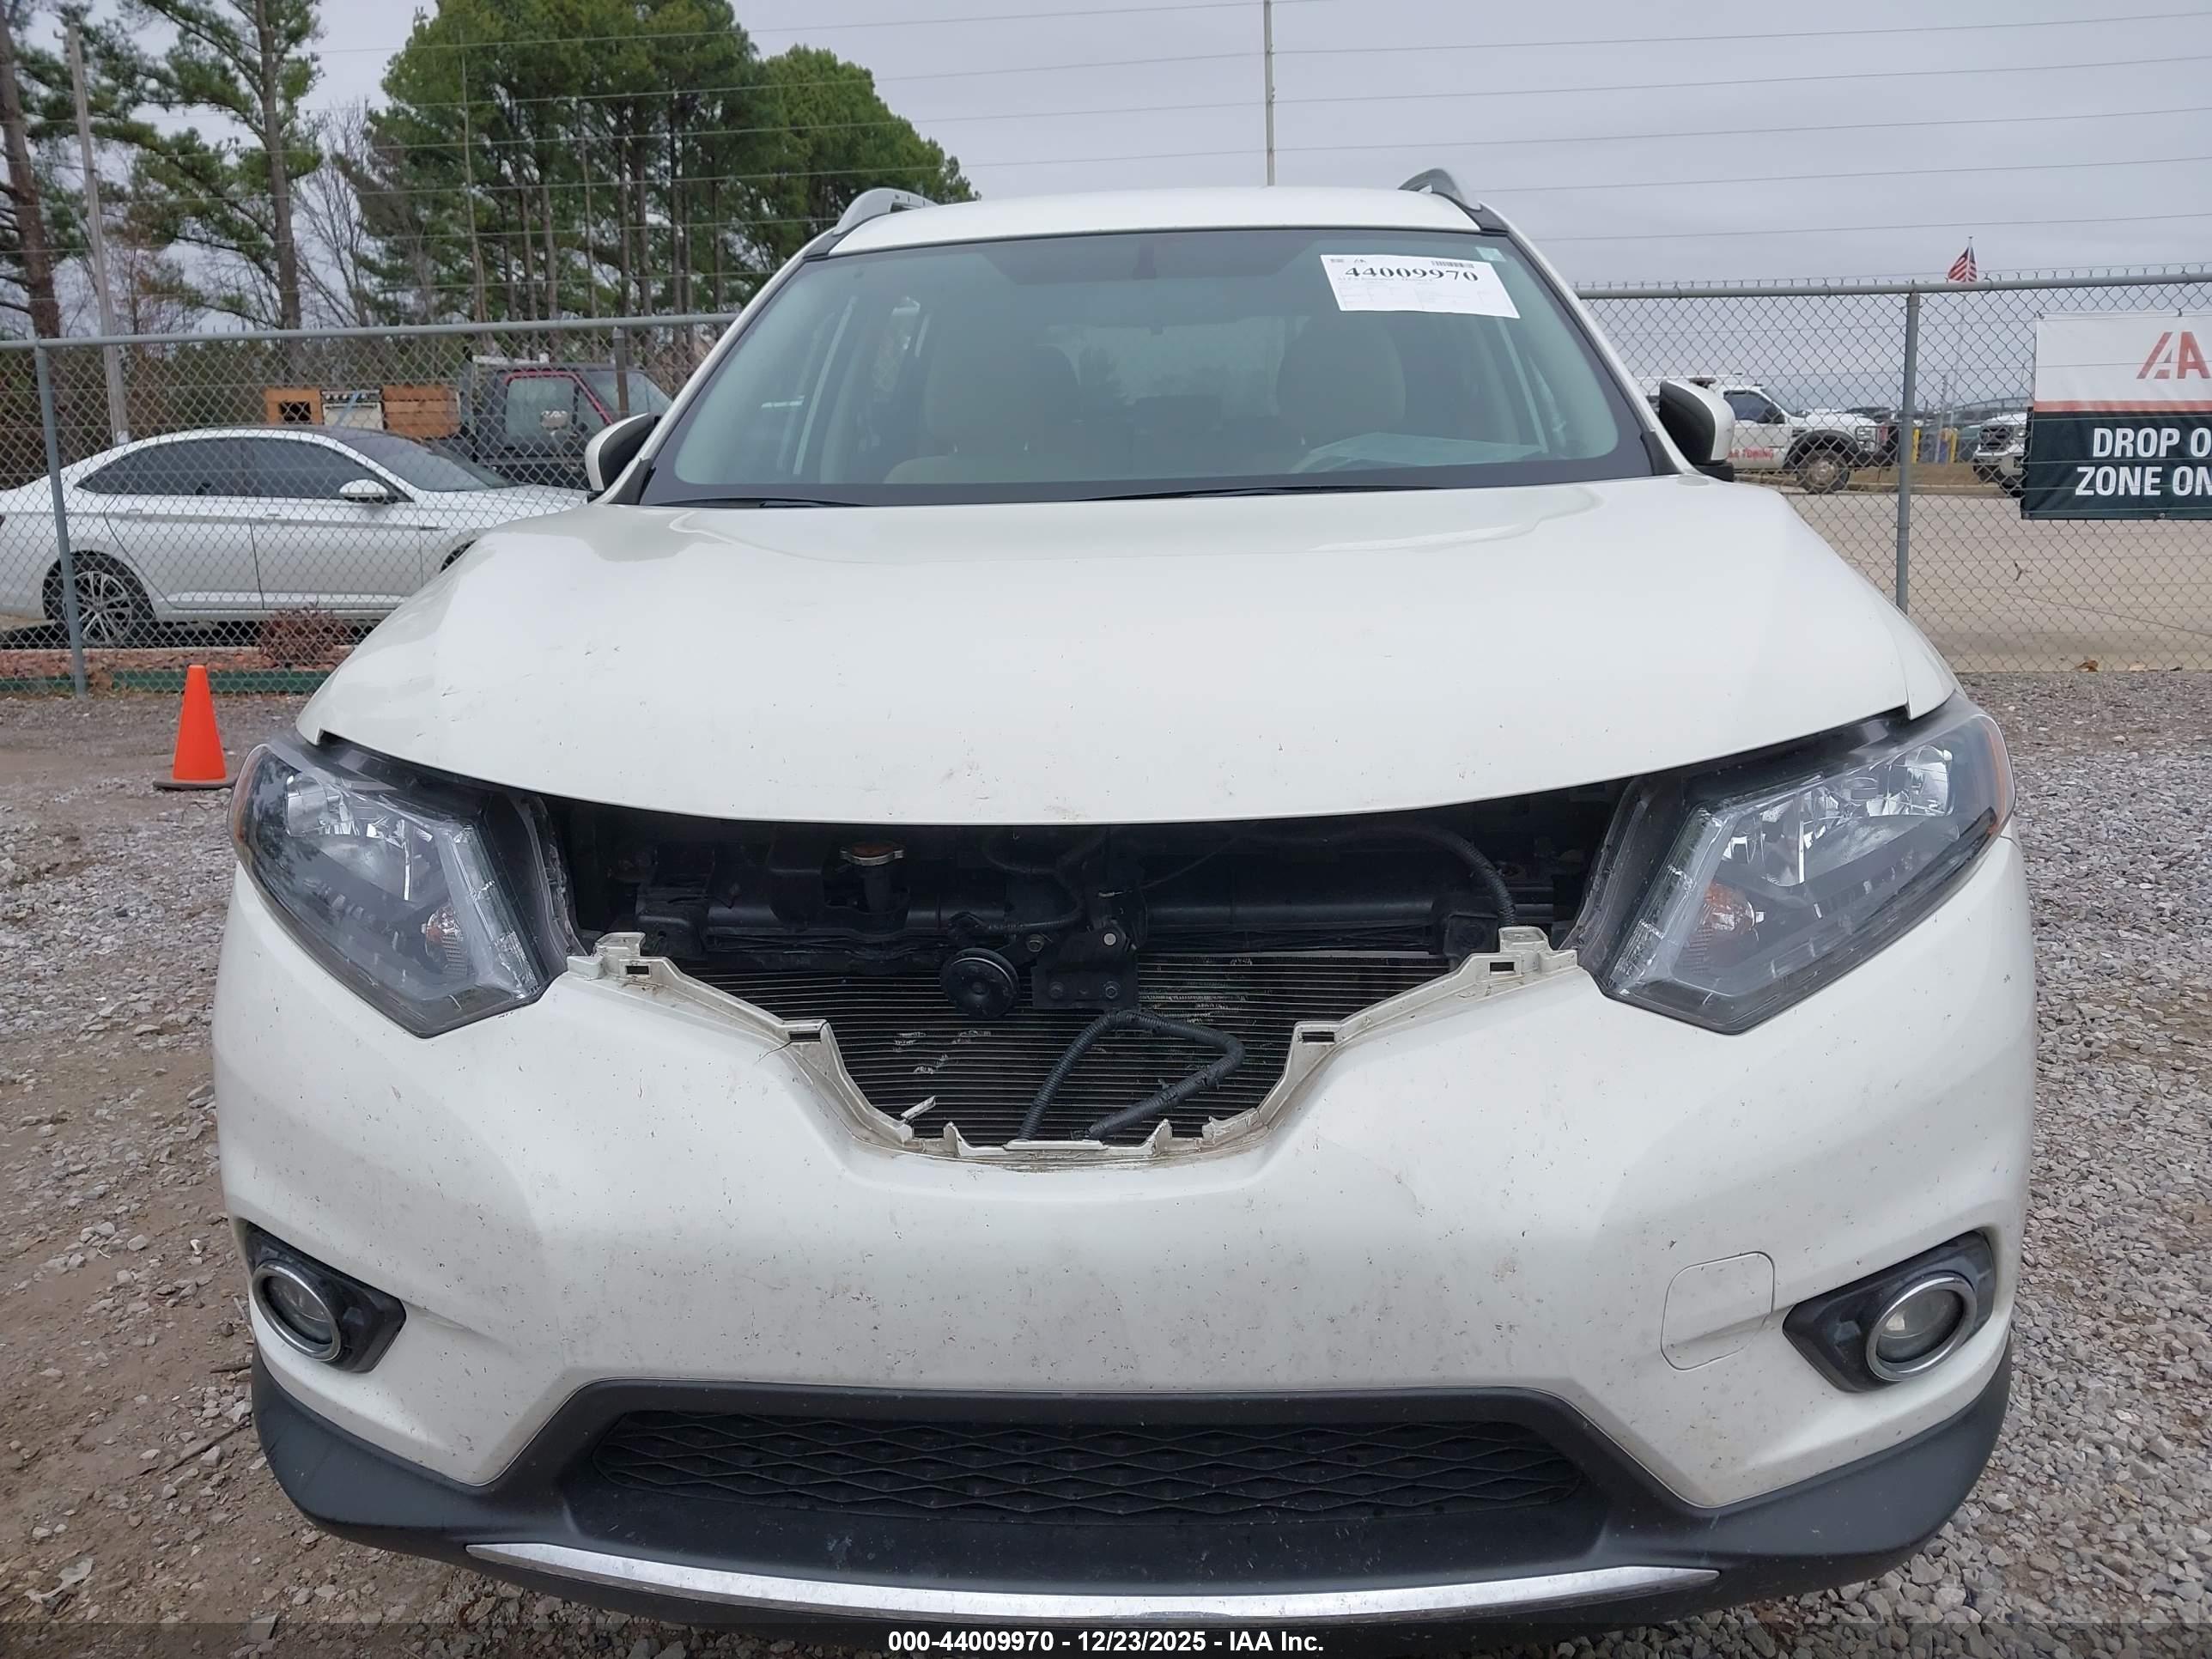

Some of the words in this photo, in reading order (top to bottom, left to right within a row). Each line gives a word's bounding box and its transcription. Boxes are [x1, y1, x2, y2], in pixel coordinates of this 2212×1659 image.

[1345, 267, 1479, 282] 44009970
[2093, 428, 2180, 458] DROP
[2075, 466, 2163, 495] ZONE
